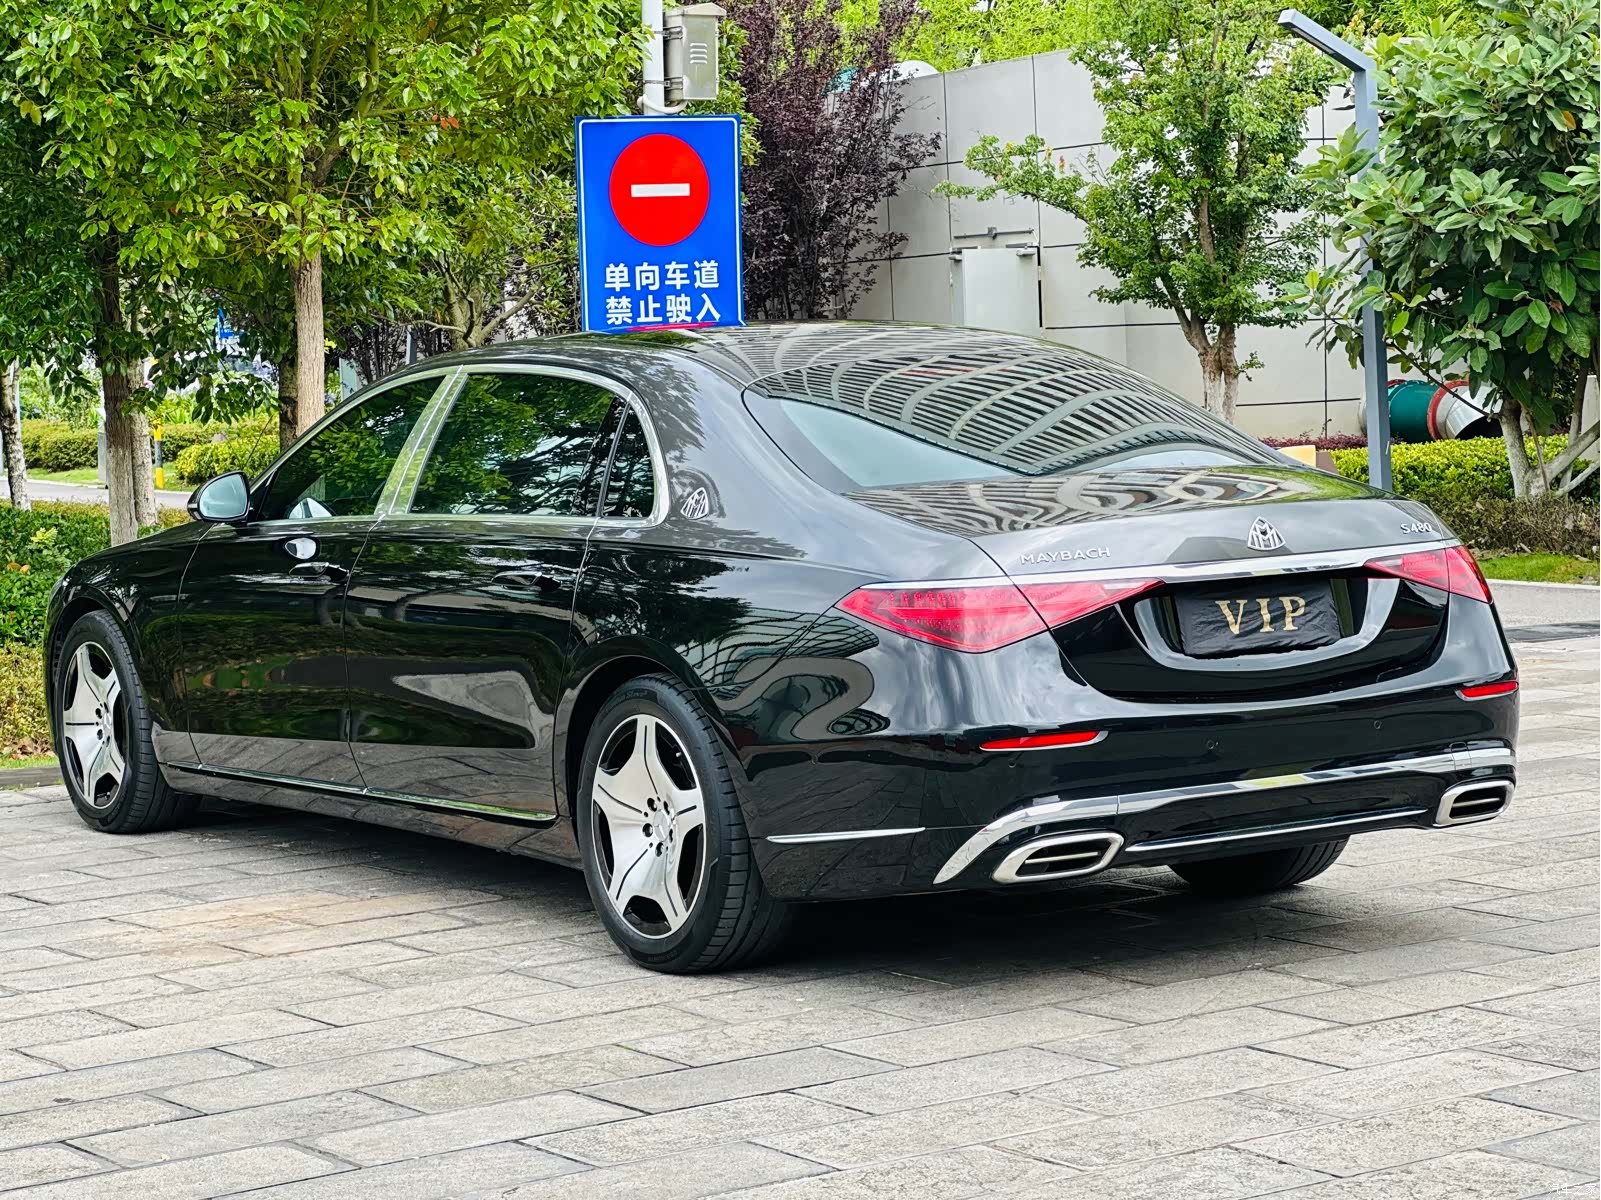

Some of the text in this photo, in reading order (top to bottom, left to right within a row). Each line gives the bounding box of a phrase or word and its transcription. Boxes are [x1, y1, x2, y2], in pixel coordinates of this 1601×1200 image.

[604, 260, 719, 292] 单向车道
[606, 293, 721, 325] 禁止驶入
[1020, 547, 1111, 565] MAYBACH
[1215, 596, 1306, 635] VIP
